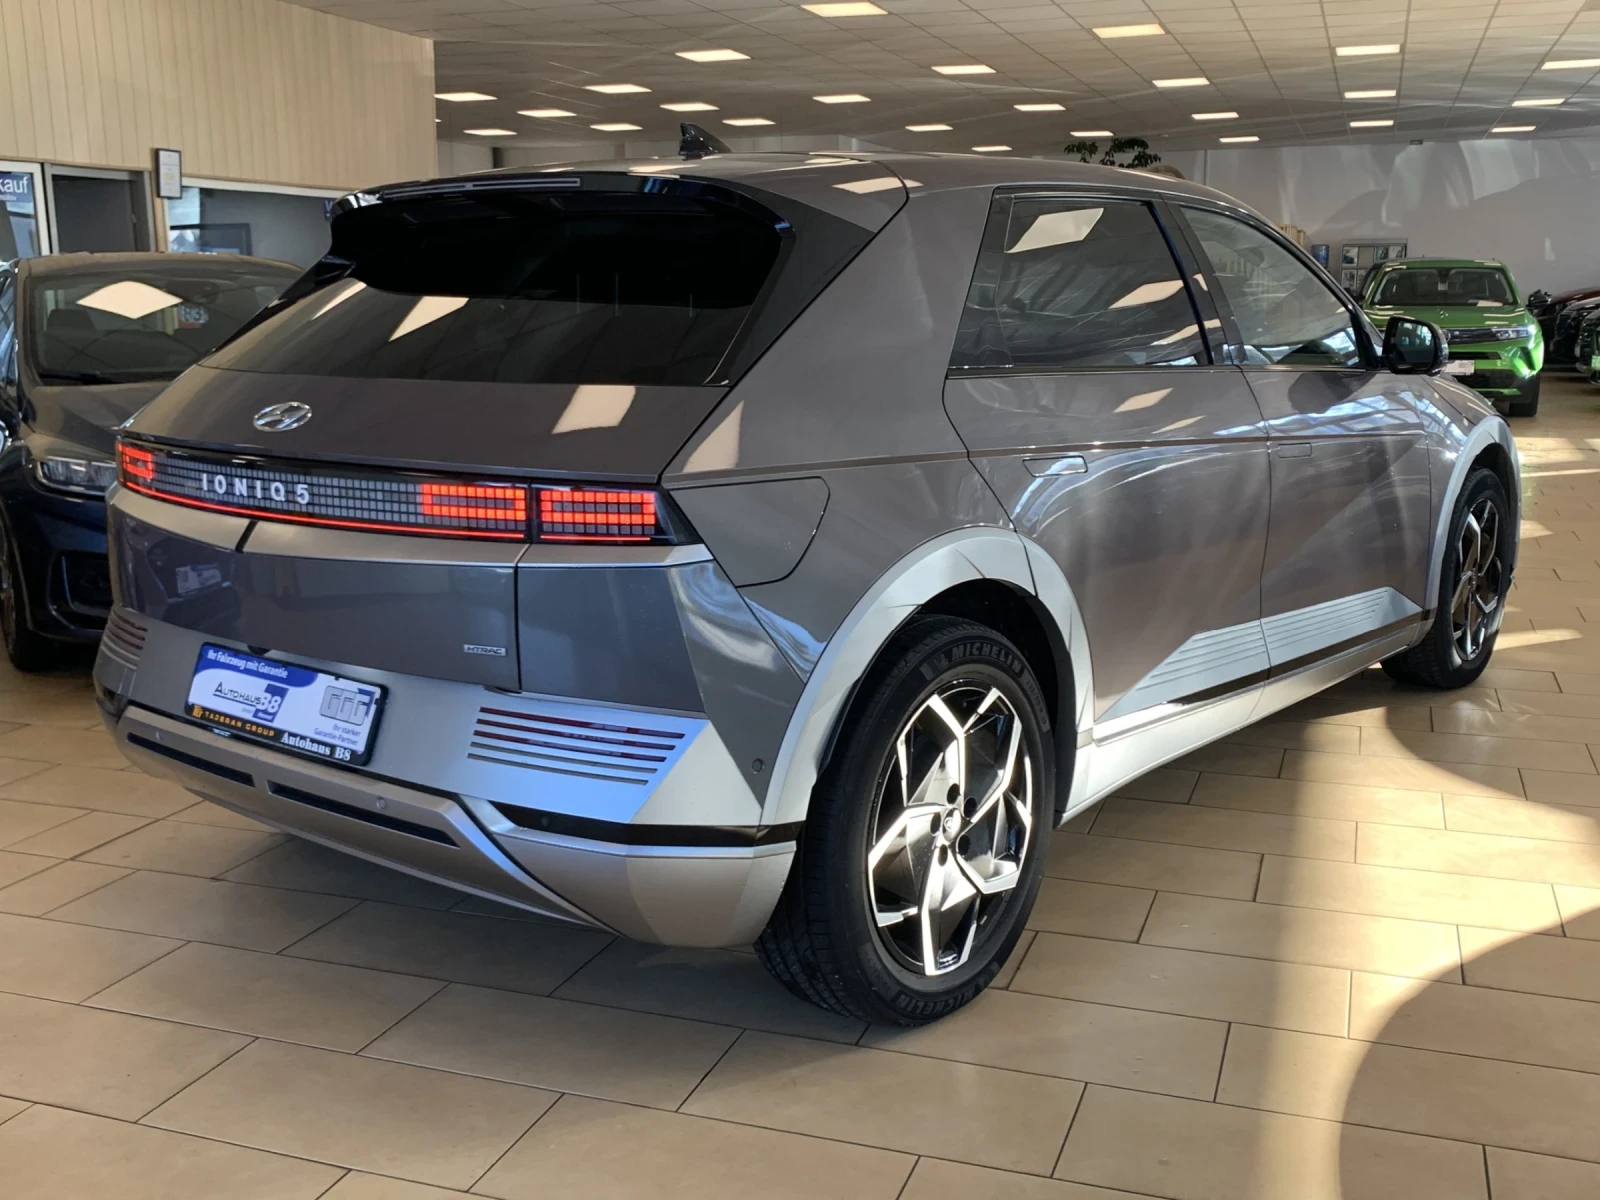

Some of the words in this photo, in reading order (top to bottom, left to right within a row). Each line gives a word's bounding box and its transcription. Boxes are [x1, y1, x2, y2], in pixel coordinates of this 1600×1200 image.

[203, 473, 285, 502] IONIQ
[297, 484, 310, 505] 5
[467, 646, 503, 655] HTRAC
[952, 642, 1022, 673] MICHELIN
[207, 649, 217, 660] Ihr
[216, 651, 247, 670] Fahrzeug
[246, 660, 258, 671] mit
[258, 662, 288, 679] Garantie
[245, 723, 275, 737] GROUP
[281, 732, 331, 755] Autohaus
